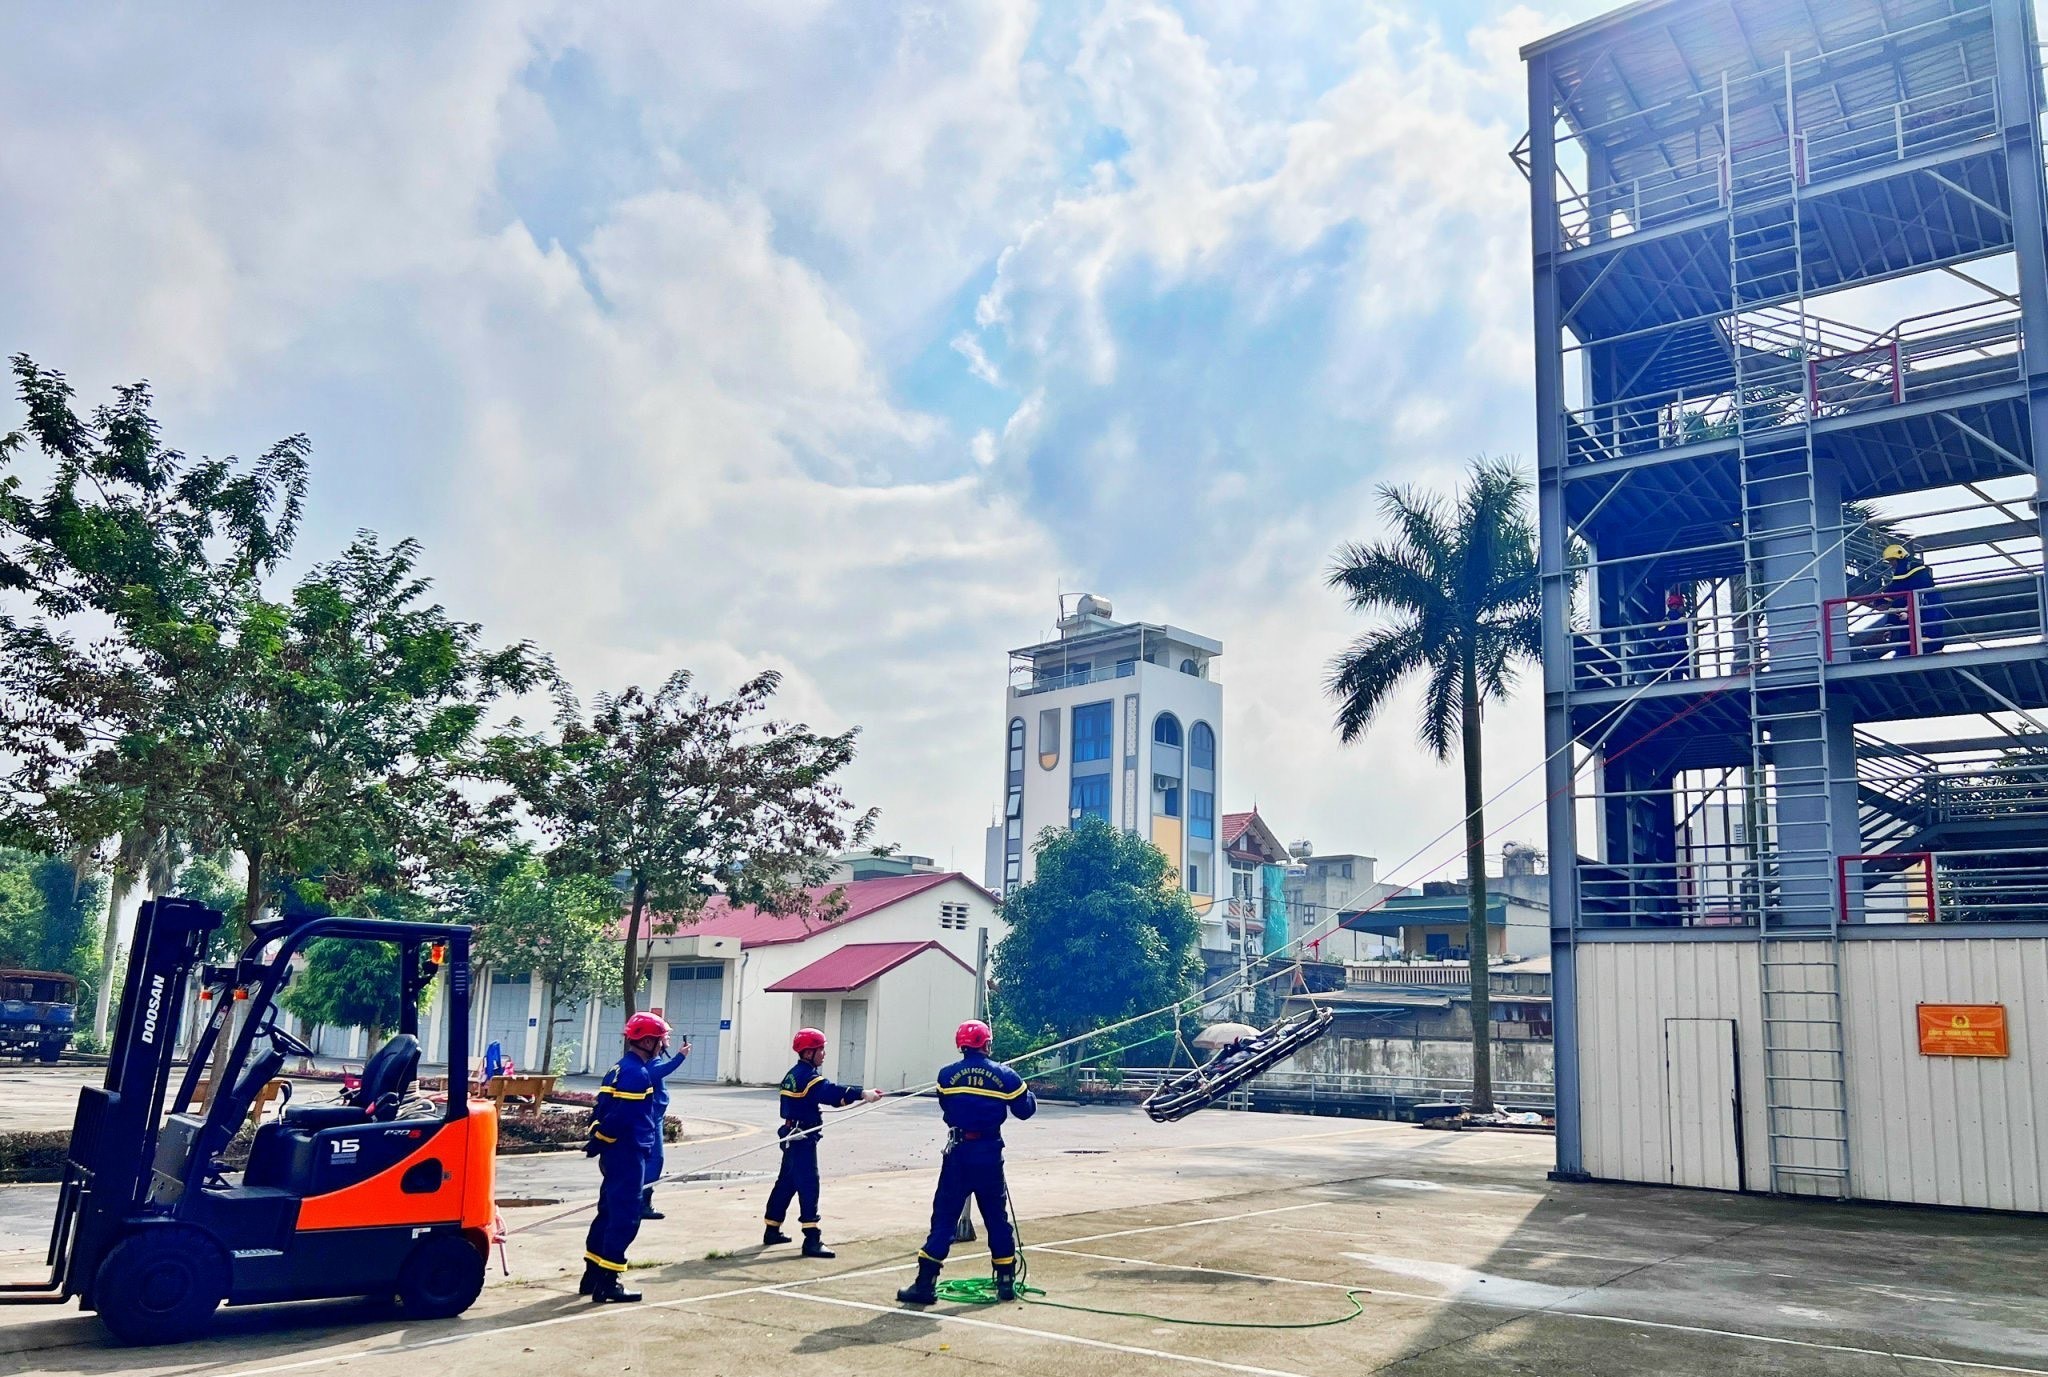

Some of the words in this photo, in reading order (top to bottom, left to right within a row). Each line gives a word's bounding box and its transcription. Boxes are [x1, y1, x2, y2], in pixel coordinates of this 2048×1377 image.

[142, 974, 165, 1044] DOOSAN
[968, 1075, 984, 1086] 114
[330, 1139, 360, 1153] 15
